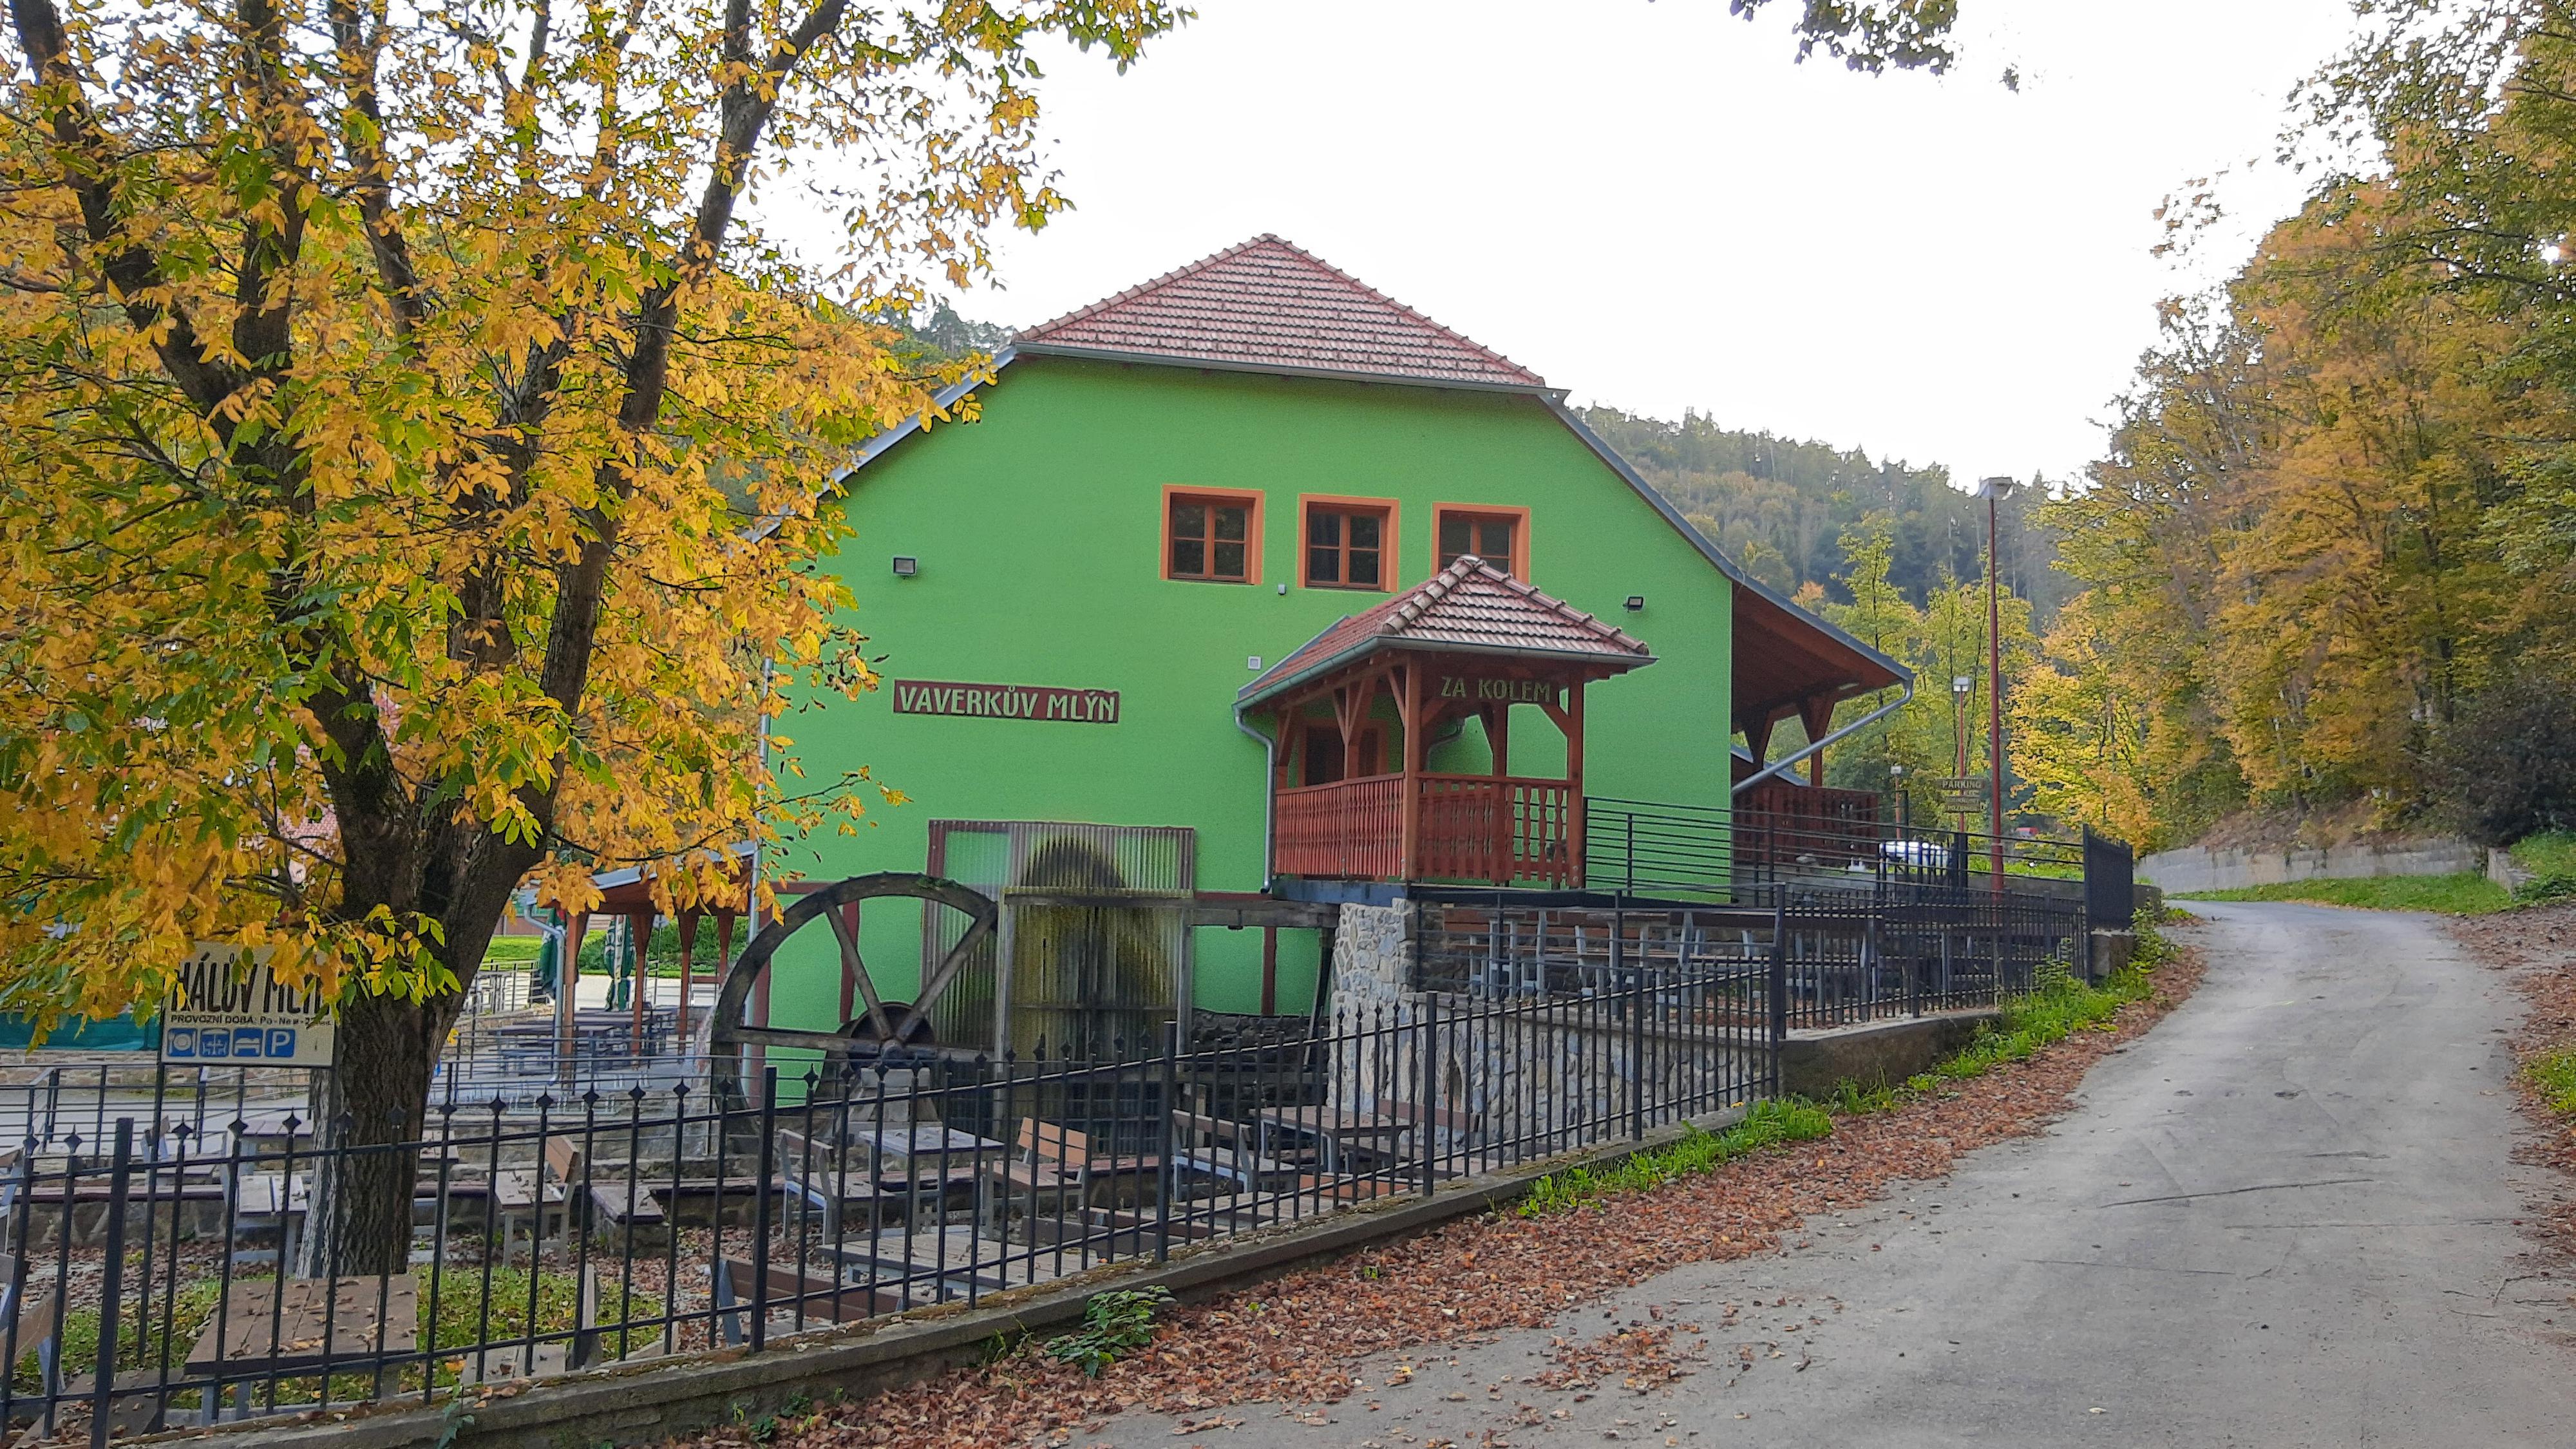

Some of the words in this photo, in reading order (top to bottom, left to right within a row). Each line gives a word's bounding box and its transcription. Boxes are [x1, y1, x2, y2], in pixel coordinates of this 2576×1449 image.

[1441, 677, 1466, 697] ZA
[1478, 679, 1551, 702] KOLEM
[899, 685, 1039, 717] VAVERKŮV
[1046, 691, 1115, 721] MLÝN
[1942, 779, 1982, 789] PARKING
[171, 1014, 222, 1023] PROVOZNÍ
[272, 1031, 290, 1056] P
